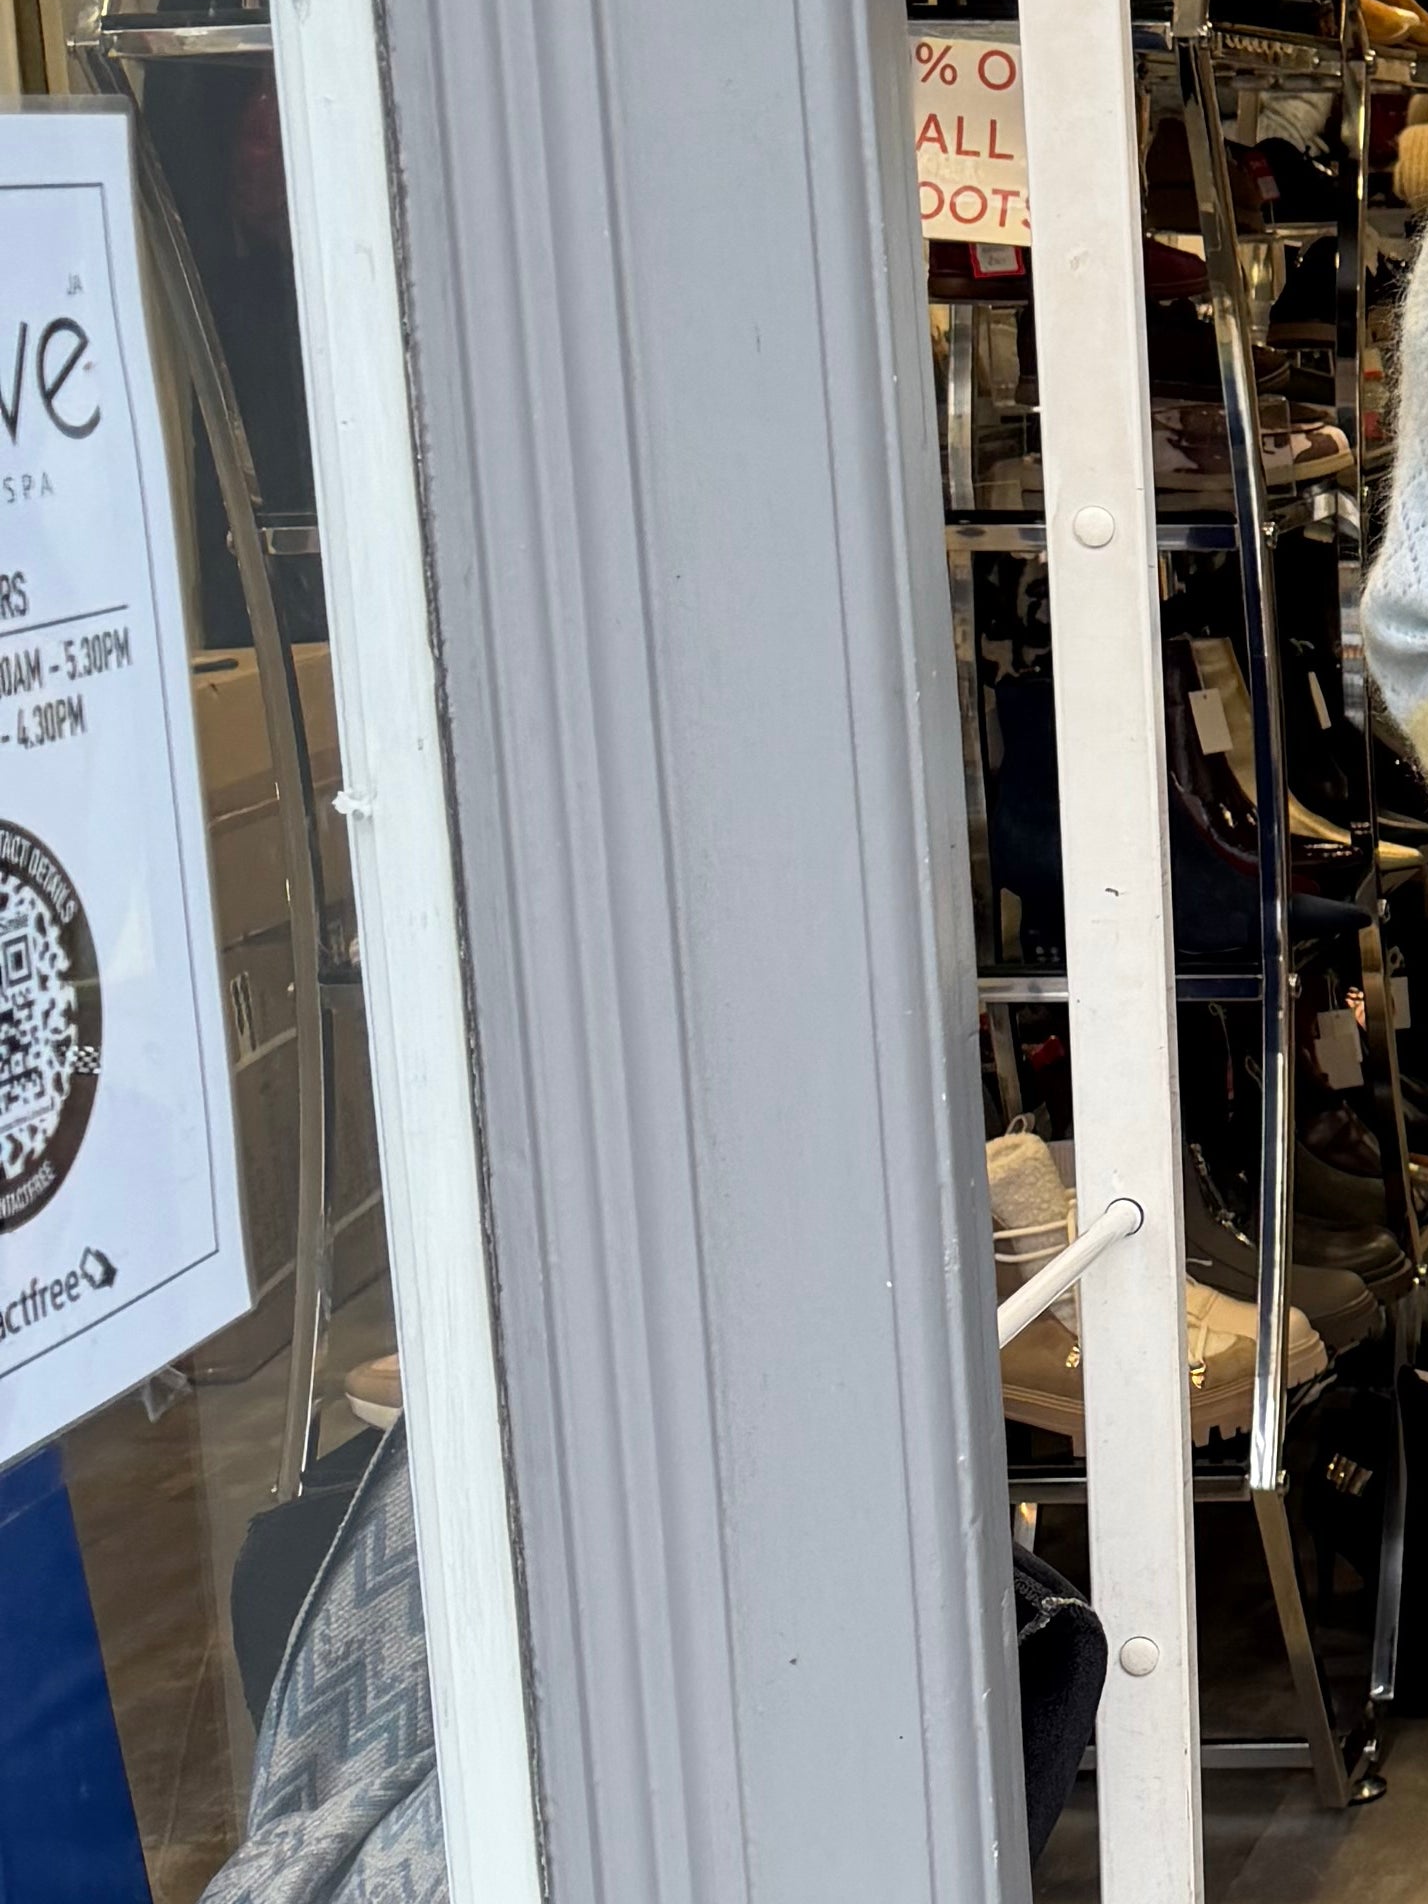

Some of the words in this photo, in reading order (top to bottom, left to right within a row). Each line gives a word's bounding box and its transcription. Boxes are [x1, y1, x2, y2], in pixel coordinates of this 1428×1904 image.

[915, 113, 1015, 161] ALL
[2, 472, 54, 504] SPA
[62, 626, 133, 681] 5.30PM
[17, 693, 87, 750] 4.30PM
[28, 848, 76, 925] DETAILS
